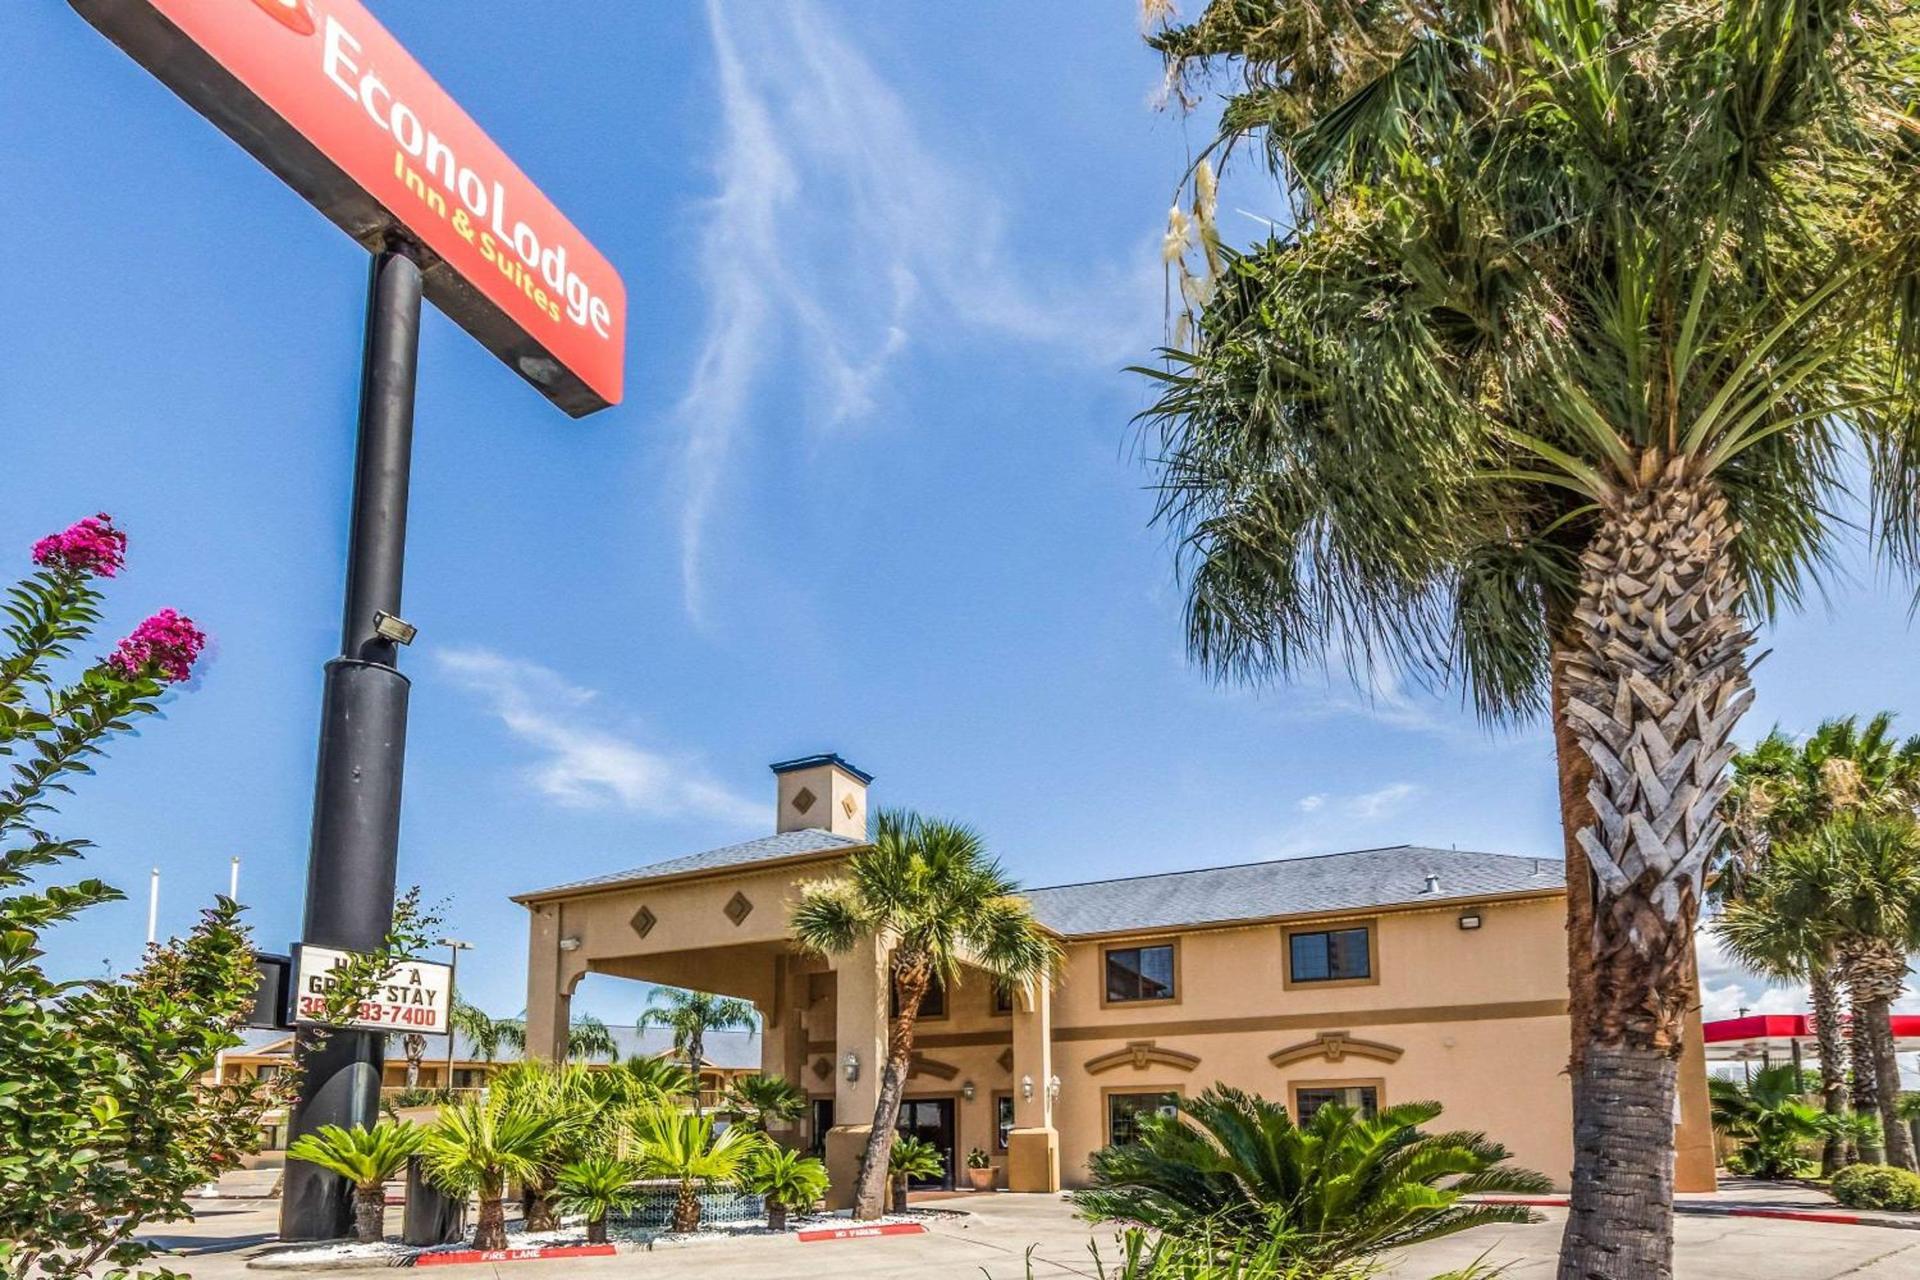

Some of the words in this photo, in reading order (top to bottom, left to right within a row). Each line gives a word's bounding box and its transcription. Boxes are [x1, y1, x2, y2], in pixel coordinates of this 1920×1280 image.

[394, 151, 446, 219] Inn
[452, 207, 475, 245] &
[480, 231, 561, 323] Suites
[409, 968, 422, 986] A
[387, 985, 437, 1006] STAY
[481, 1250, 507, 1260] FIRE
[512, 1248, 541, 1259] LANE
